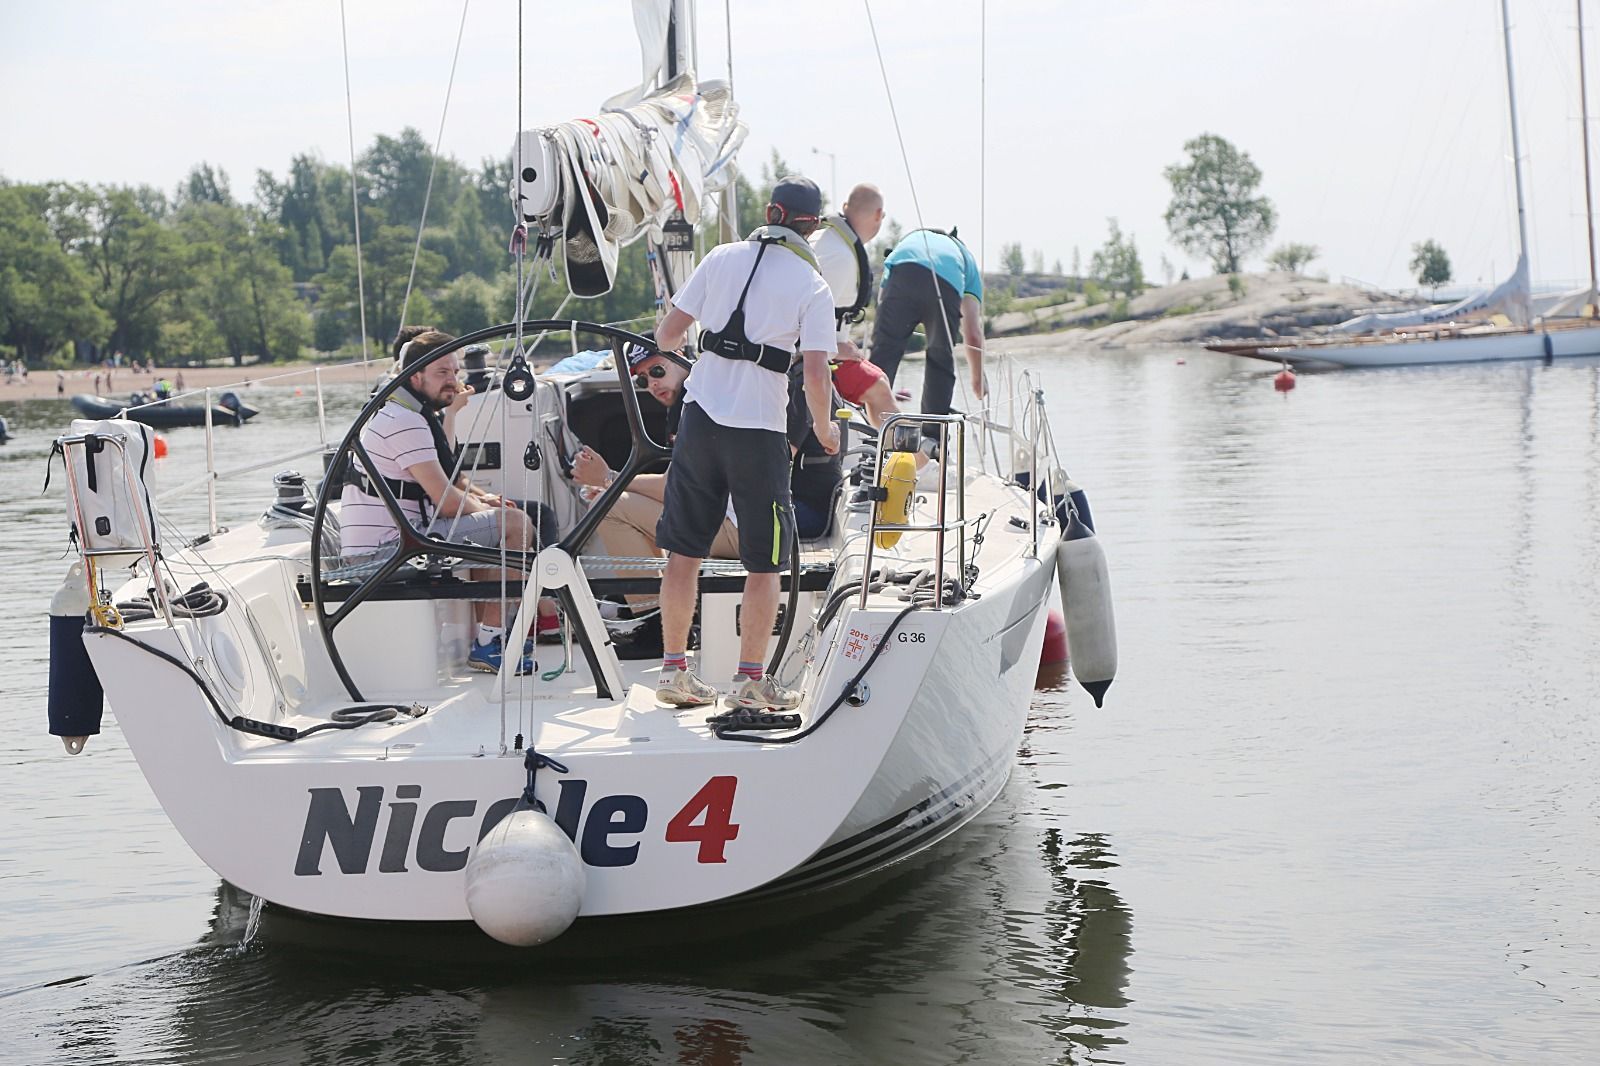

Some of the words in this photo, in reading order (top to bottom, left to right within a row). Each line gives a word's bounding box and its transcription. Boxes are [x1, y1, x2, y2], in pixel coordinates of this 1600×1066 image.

[849, 628, 869, 641] 2015
[898, 632, 908, 643] G
[910, 632, 926, 643] 36
[665, 776, 740, 864] 4
